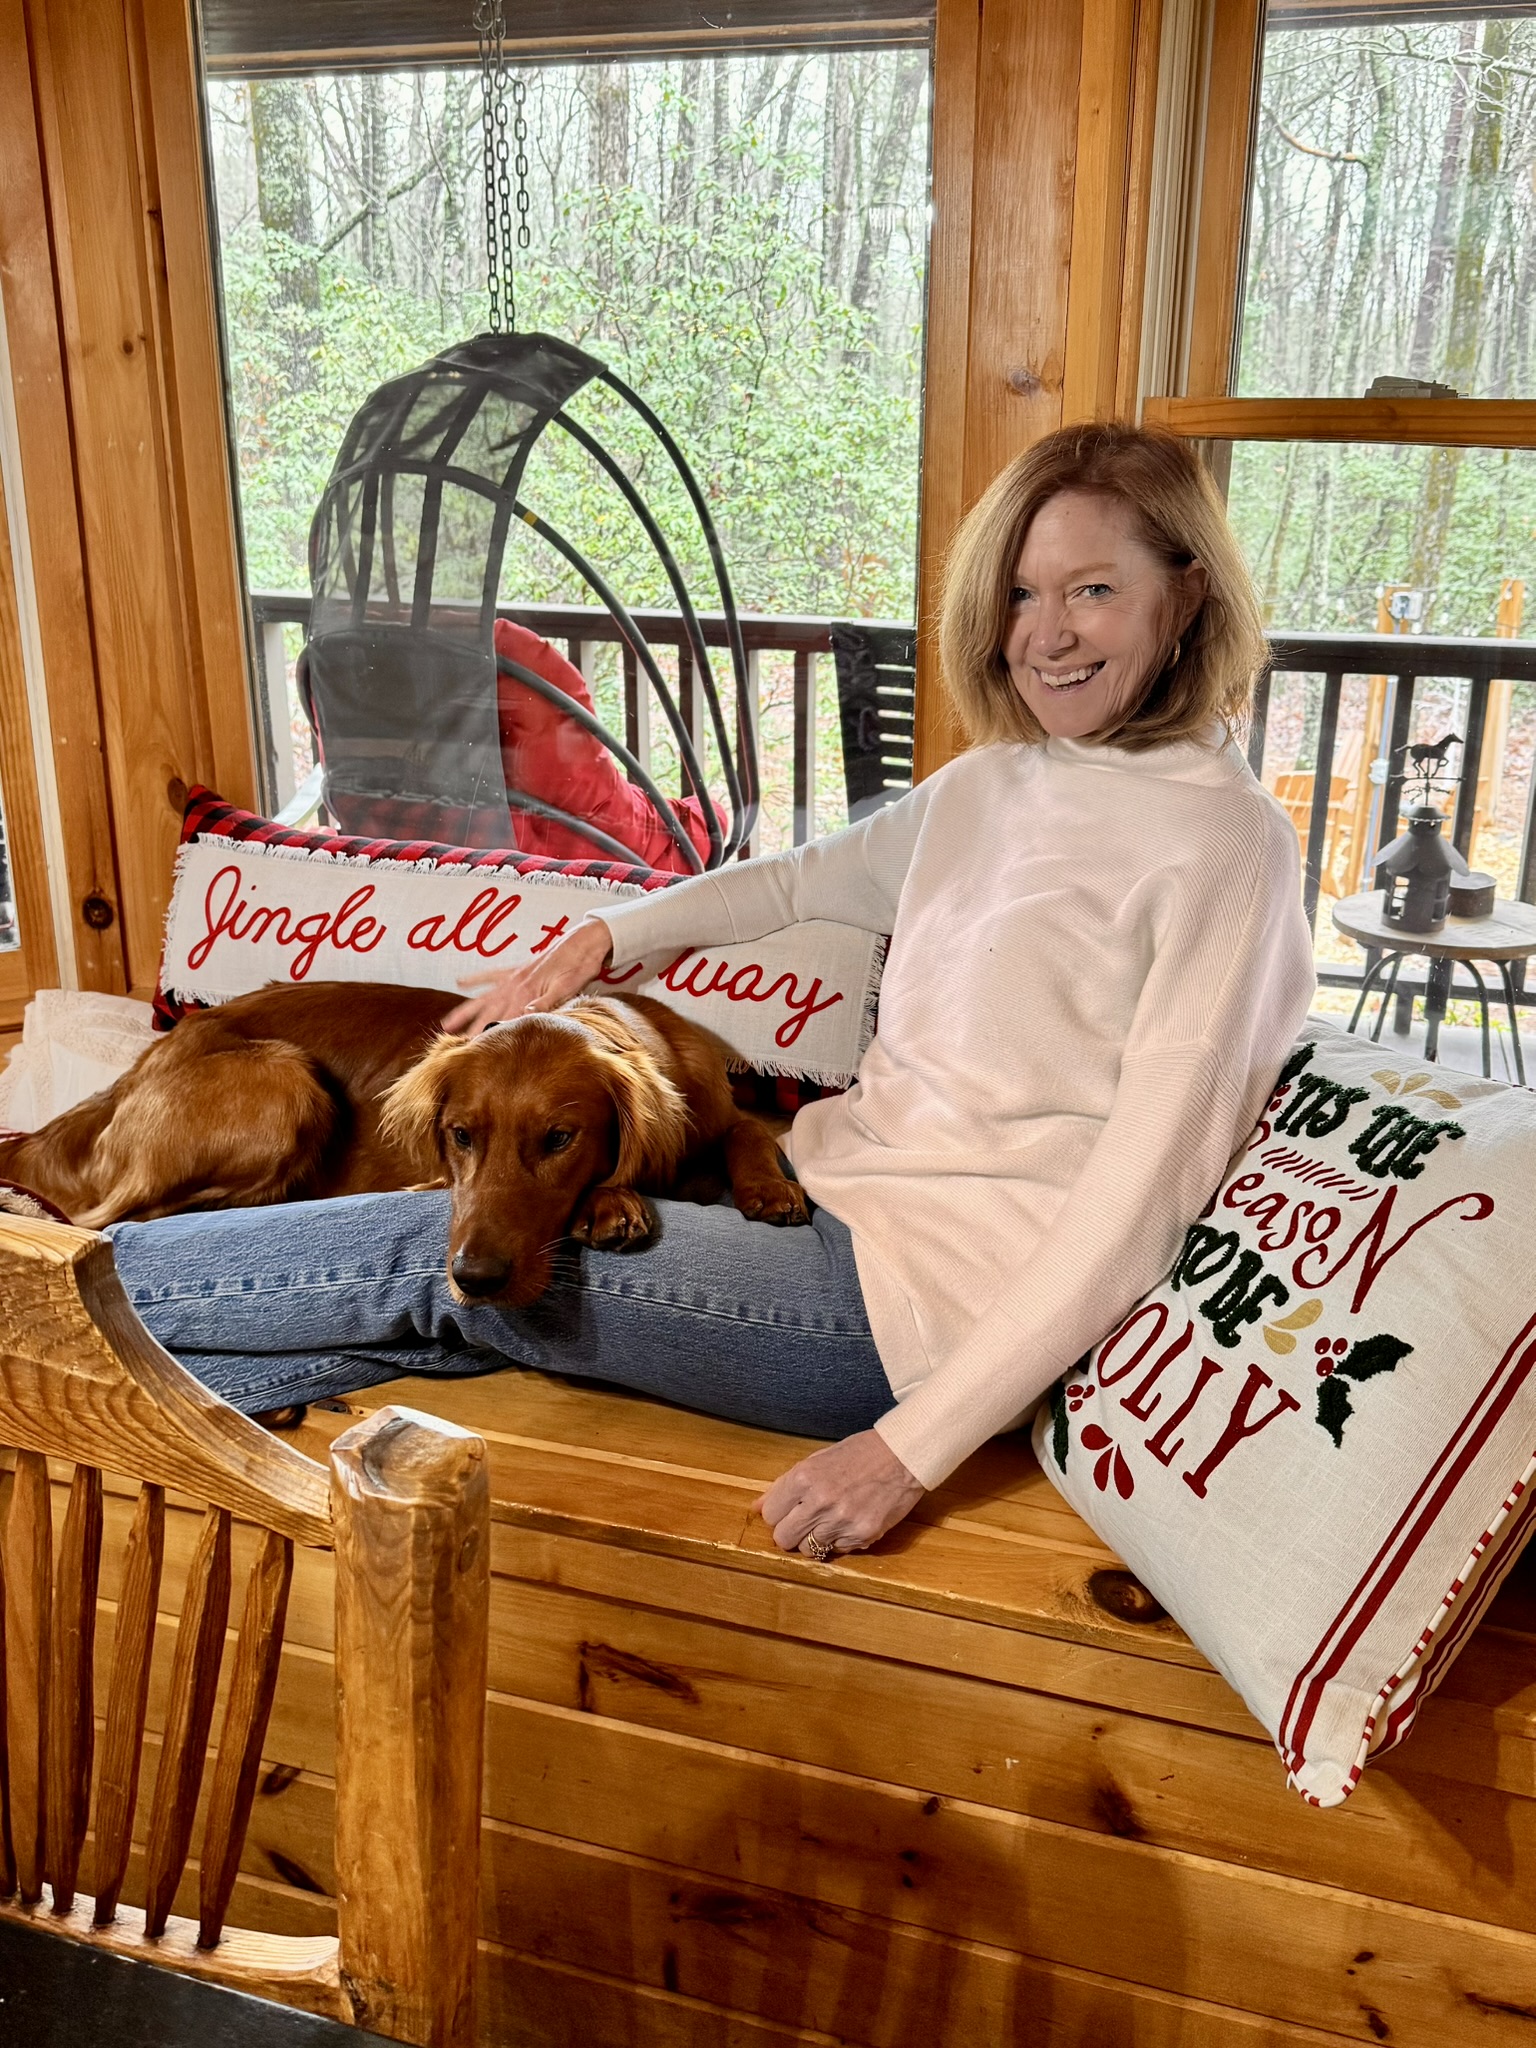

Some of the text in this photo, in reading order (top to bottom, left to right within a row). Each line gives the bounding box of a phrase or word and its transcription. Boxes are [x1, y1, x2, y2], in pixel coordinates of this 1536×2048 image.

[187, 865, 387, 981] Jingle
[407, 887, 522, 957] all
[657, 946, 844, 1048] way
[1348, 1104, 1466, 1180] THE
[1198, 1248, 1290, 1348] BE
[1097, 1302, 1301, 1499] OLLY
